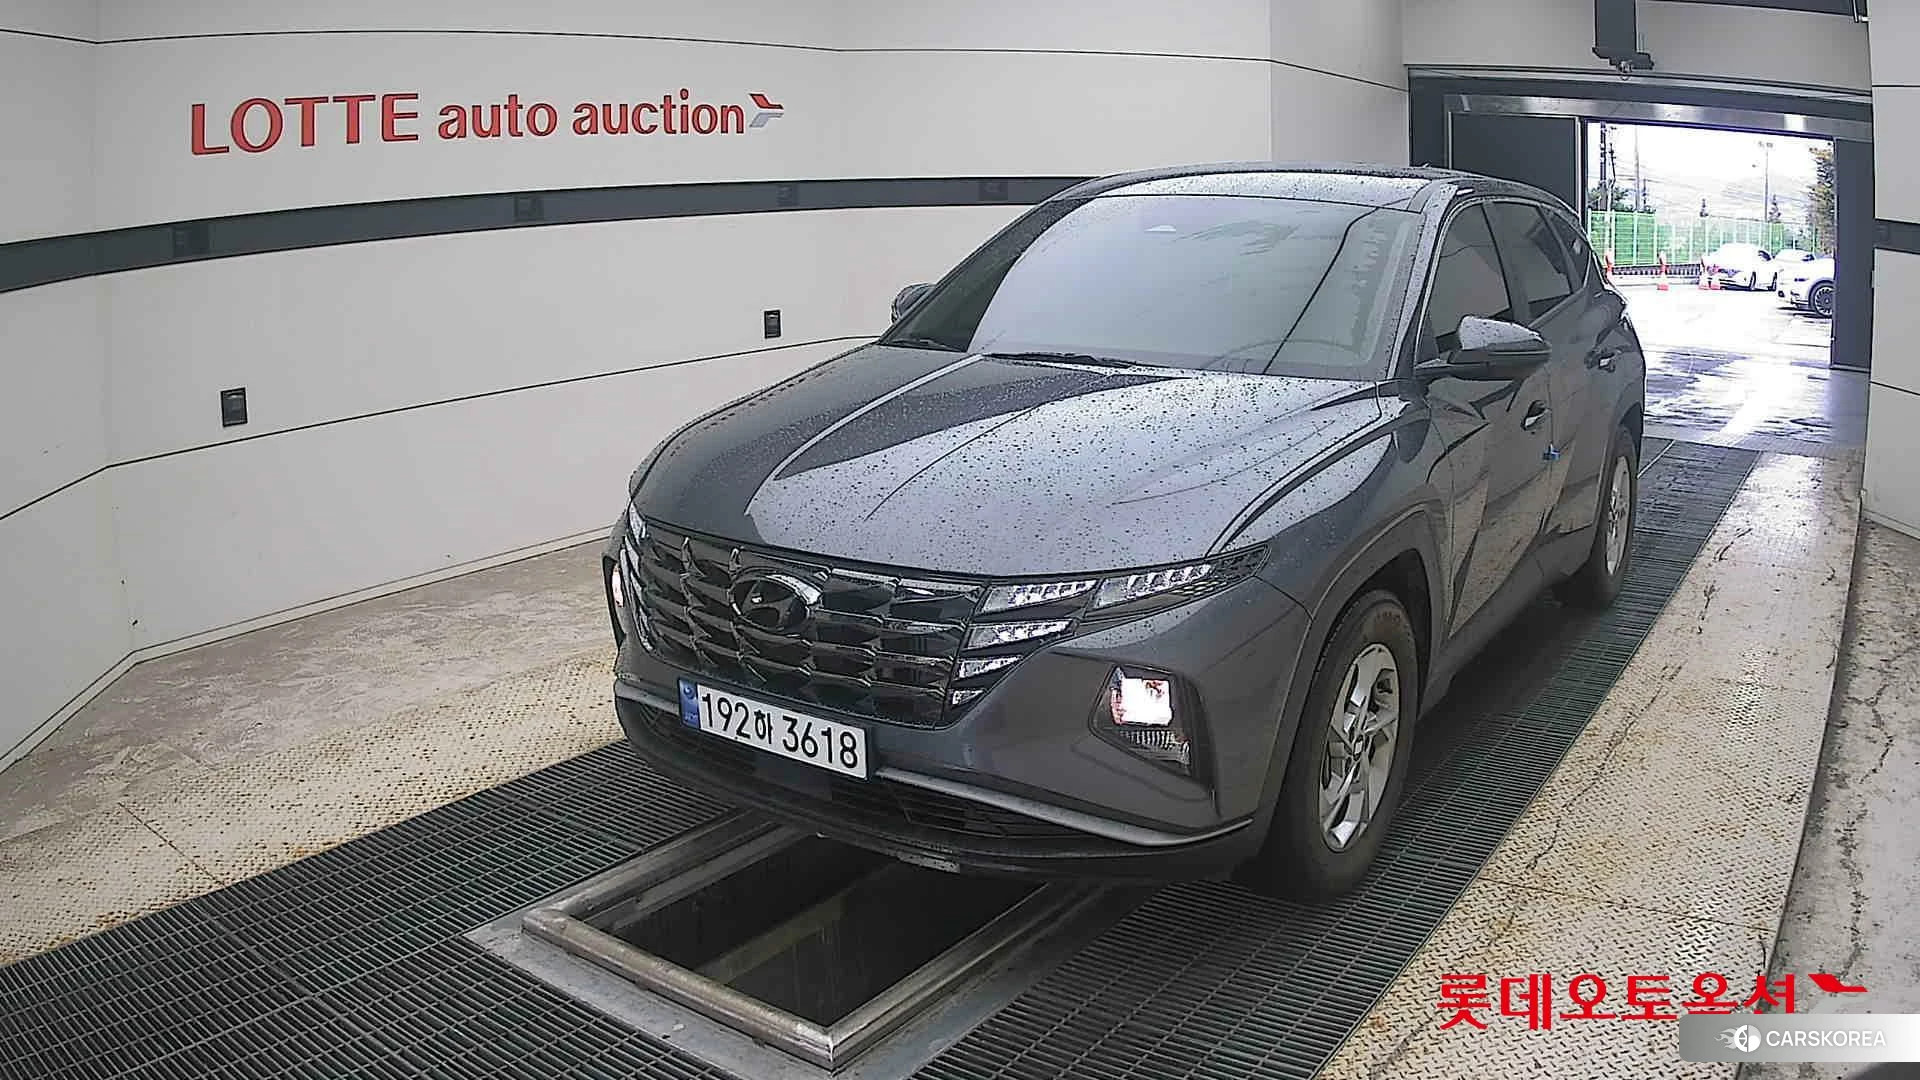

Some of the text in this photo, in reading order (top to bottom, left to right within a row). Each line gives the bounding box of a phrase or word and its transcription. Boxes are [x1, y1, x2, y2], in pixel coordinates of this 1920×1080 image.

[190, 88, 745, 156] LOTTE auto auction
[701, 692, 859, 769] 192하 3618
